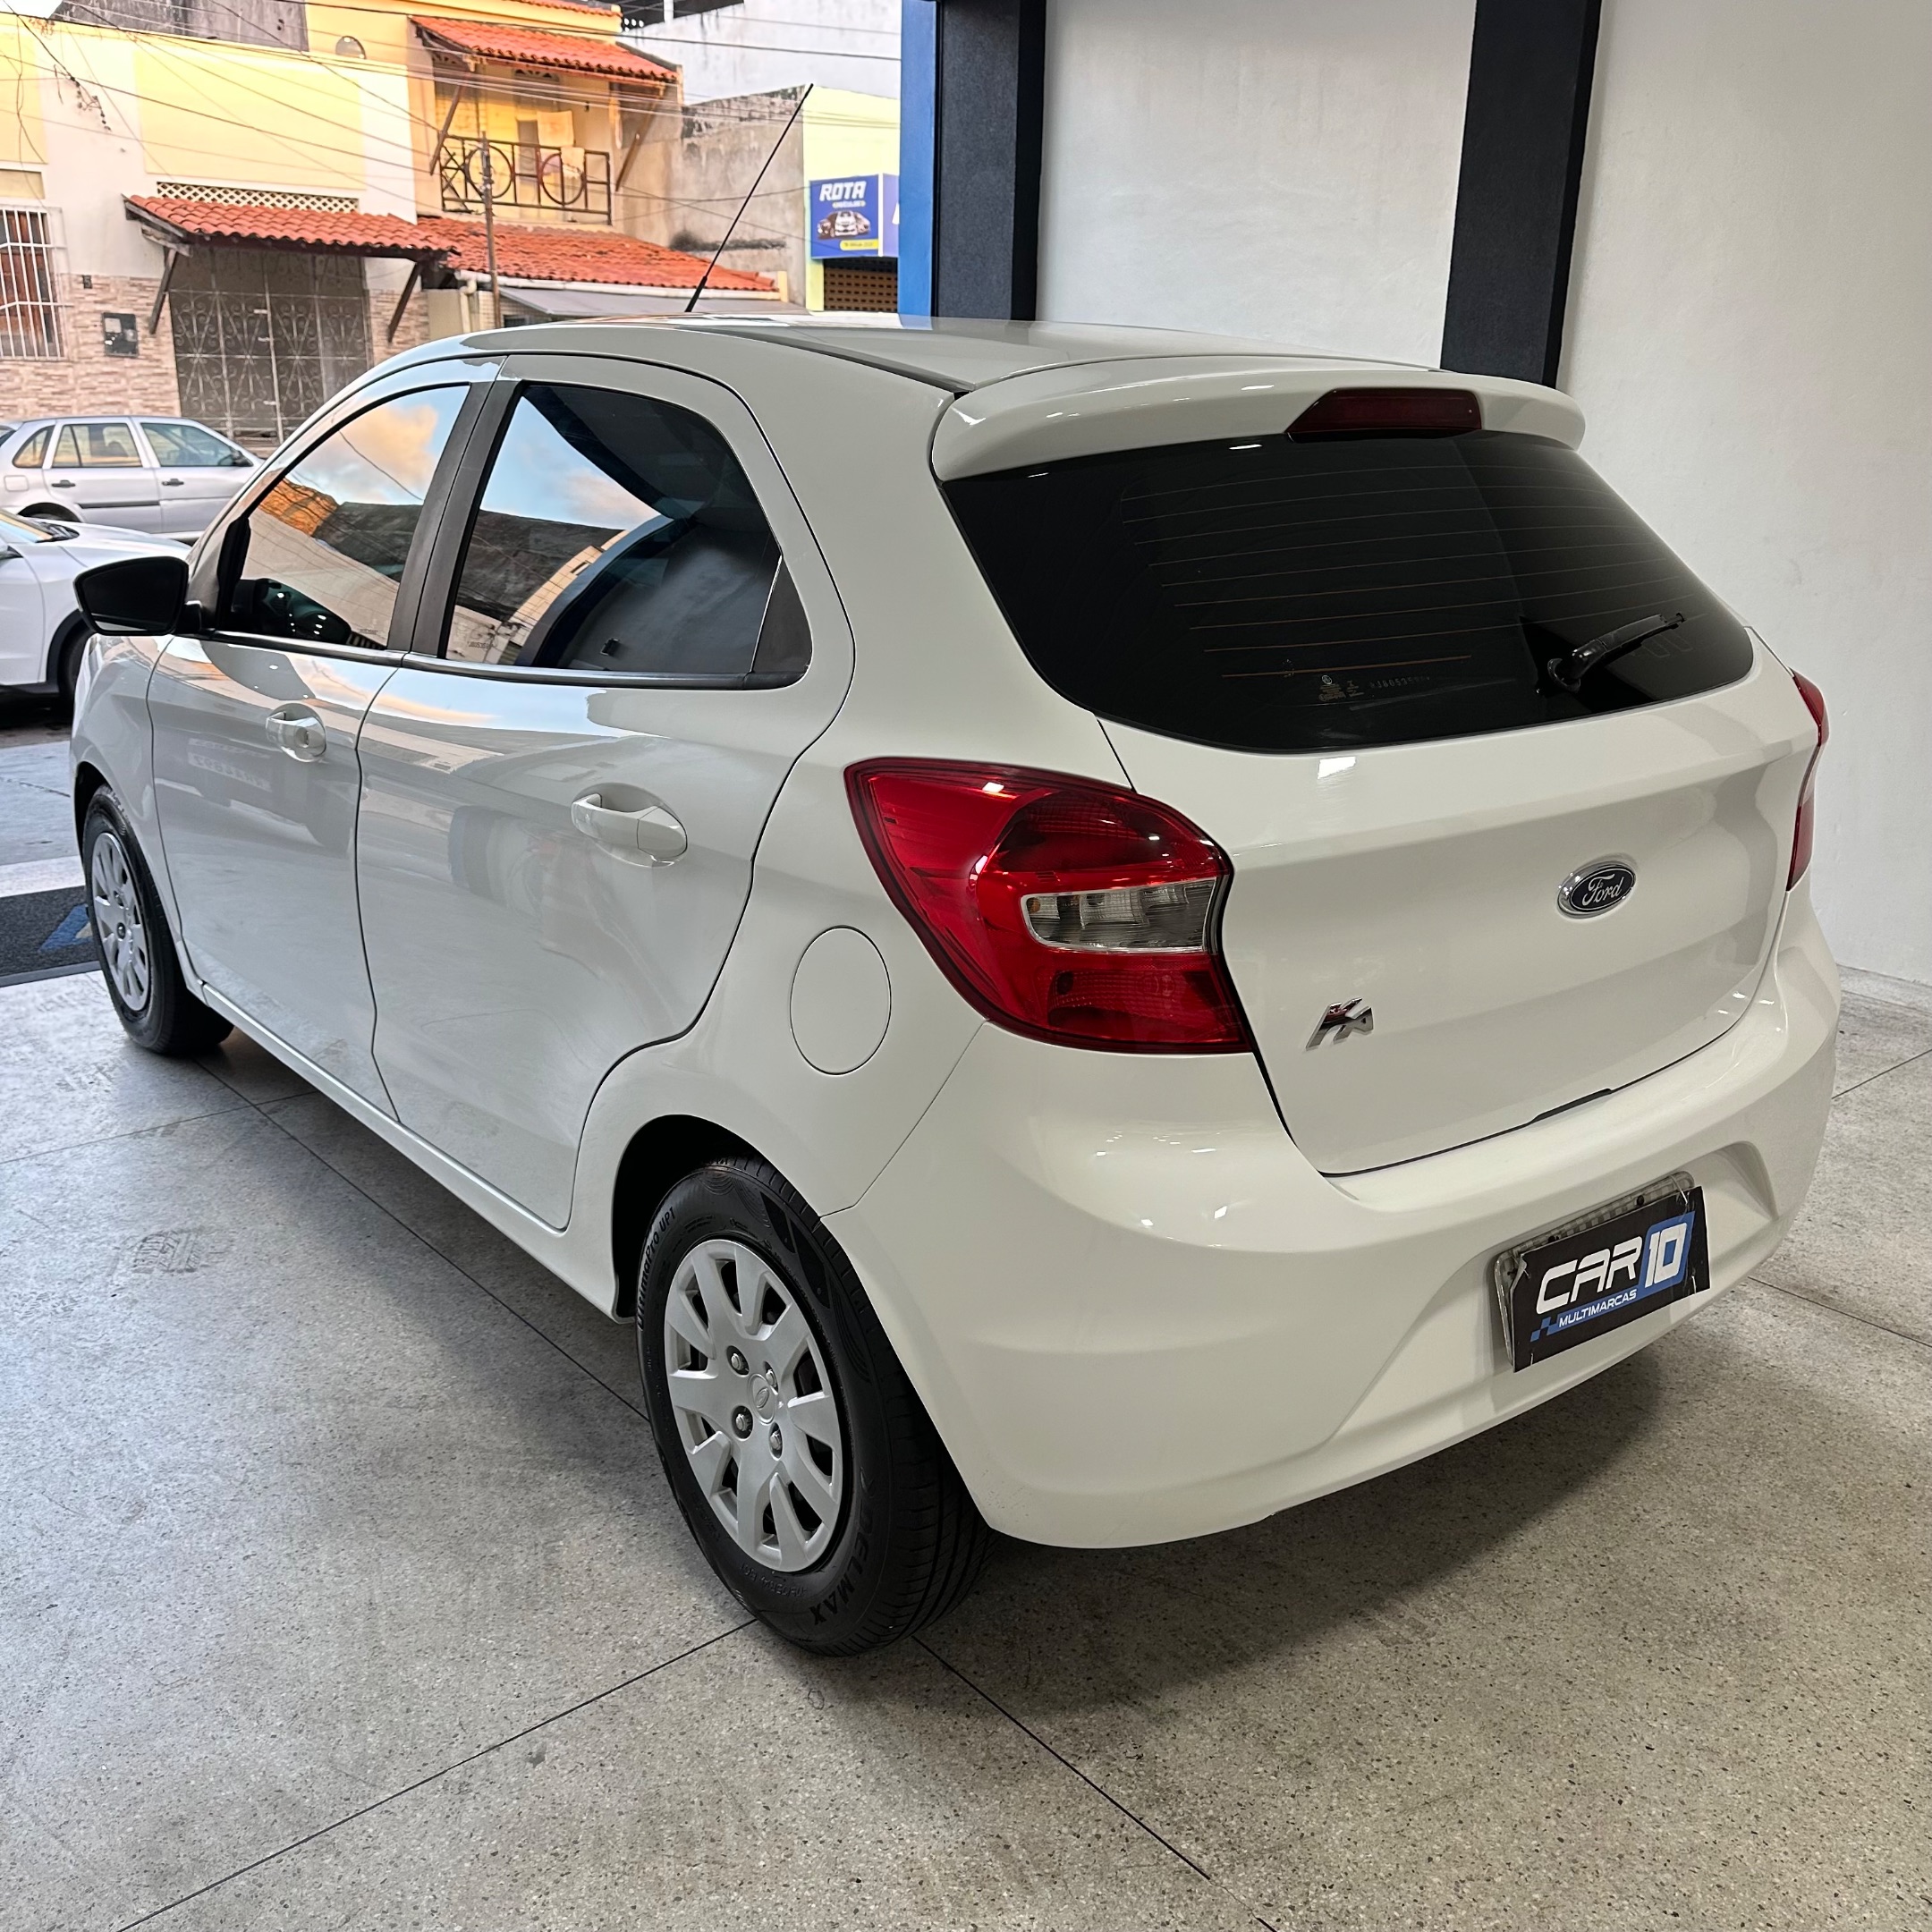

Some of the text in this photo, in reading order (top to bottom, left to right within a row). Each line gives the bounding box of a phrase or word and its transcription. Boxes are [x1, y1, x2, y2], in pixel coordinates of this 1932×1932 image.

[819, 181, 867, 201] ROTA
[1581, 874, 1624, 906] Ford
[1558, 1288, 1637, 1328] MULTIMARCAS
